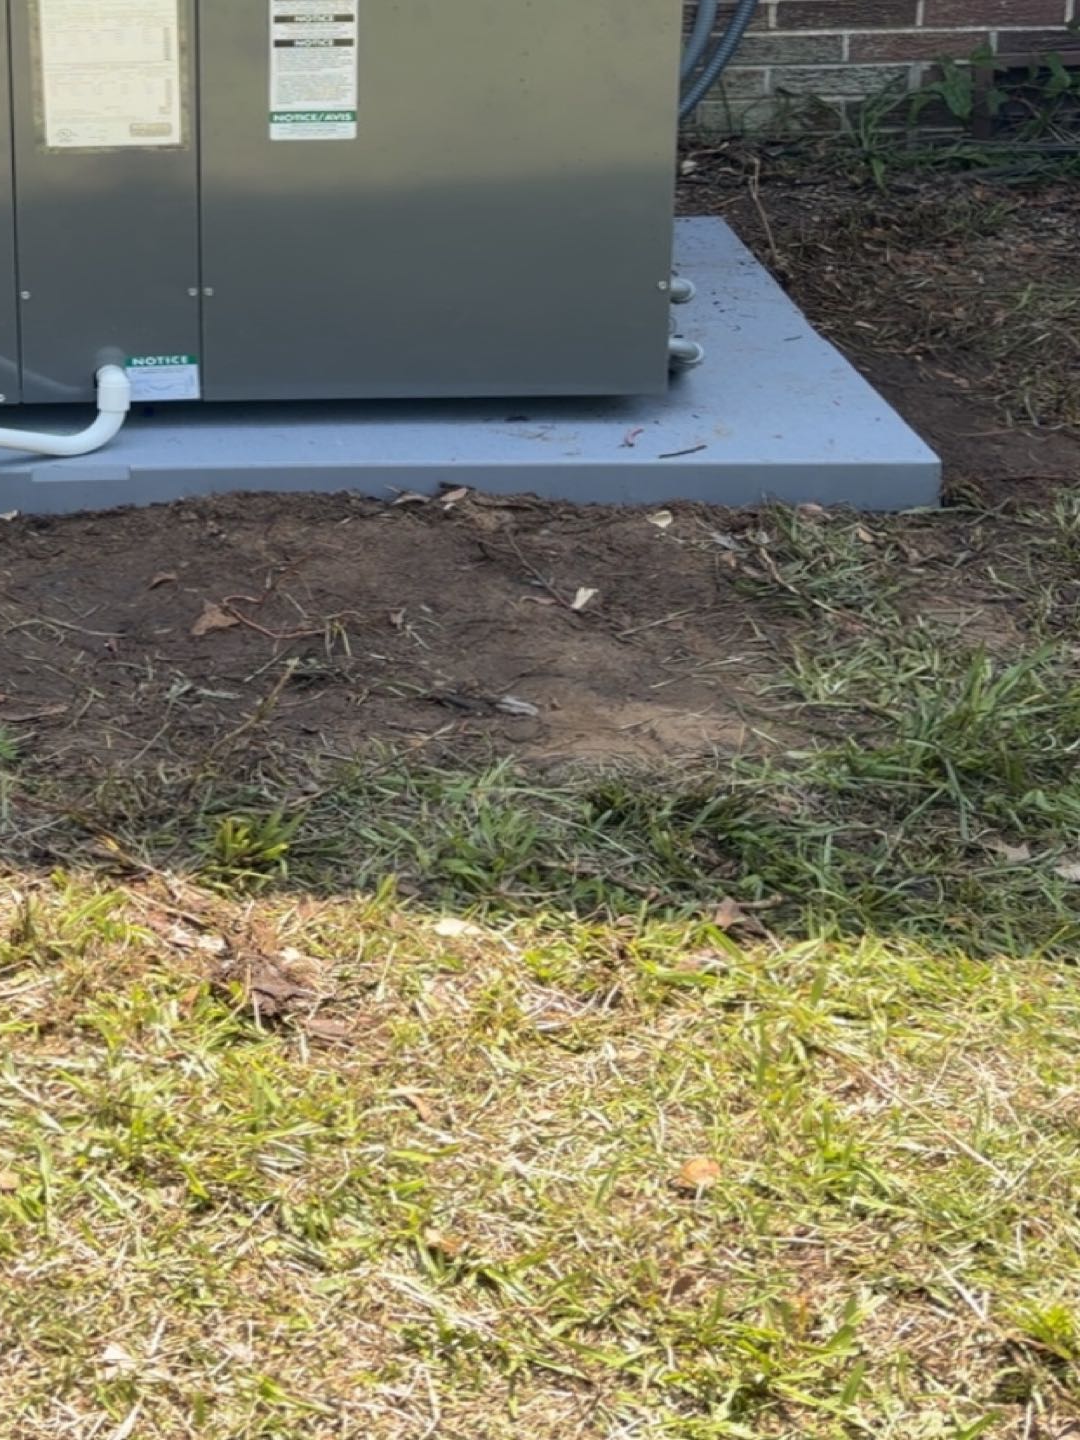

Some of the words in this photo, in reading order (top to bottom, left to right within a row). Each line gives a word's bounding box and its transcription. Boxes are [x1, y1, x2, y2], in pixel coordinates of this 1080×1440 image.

[295, 14, 334, 22] NOTICE
[295, 39, 334, 47] NOTICE
[131, 355, 188, 366] NOTICE
